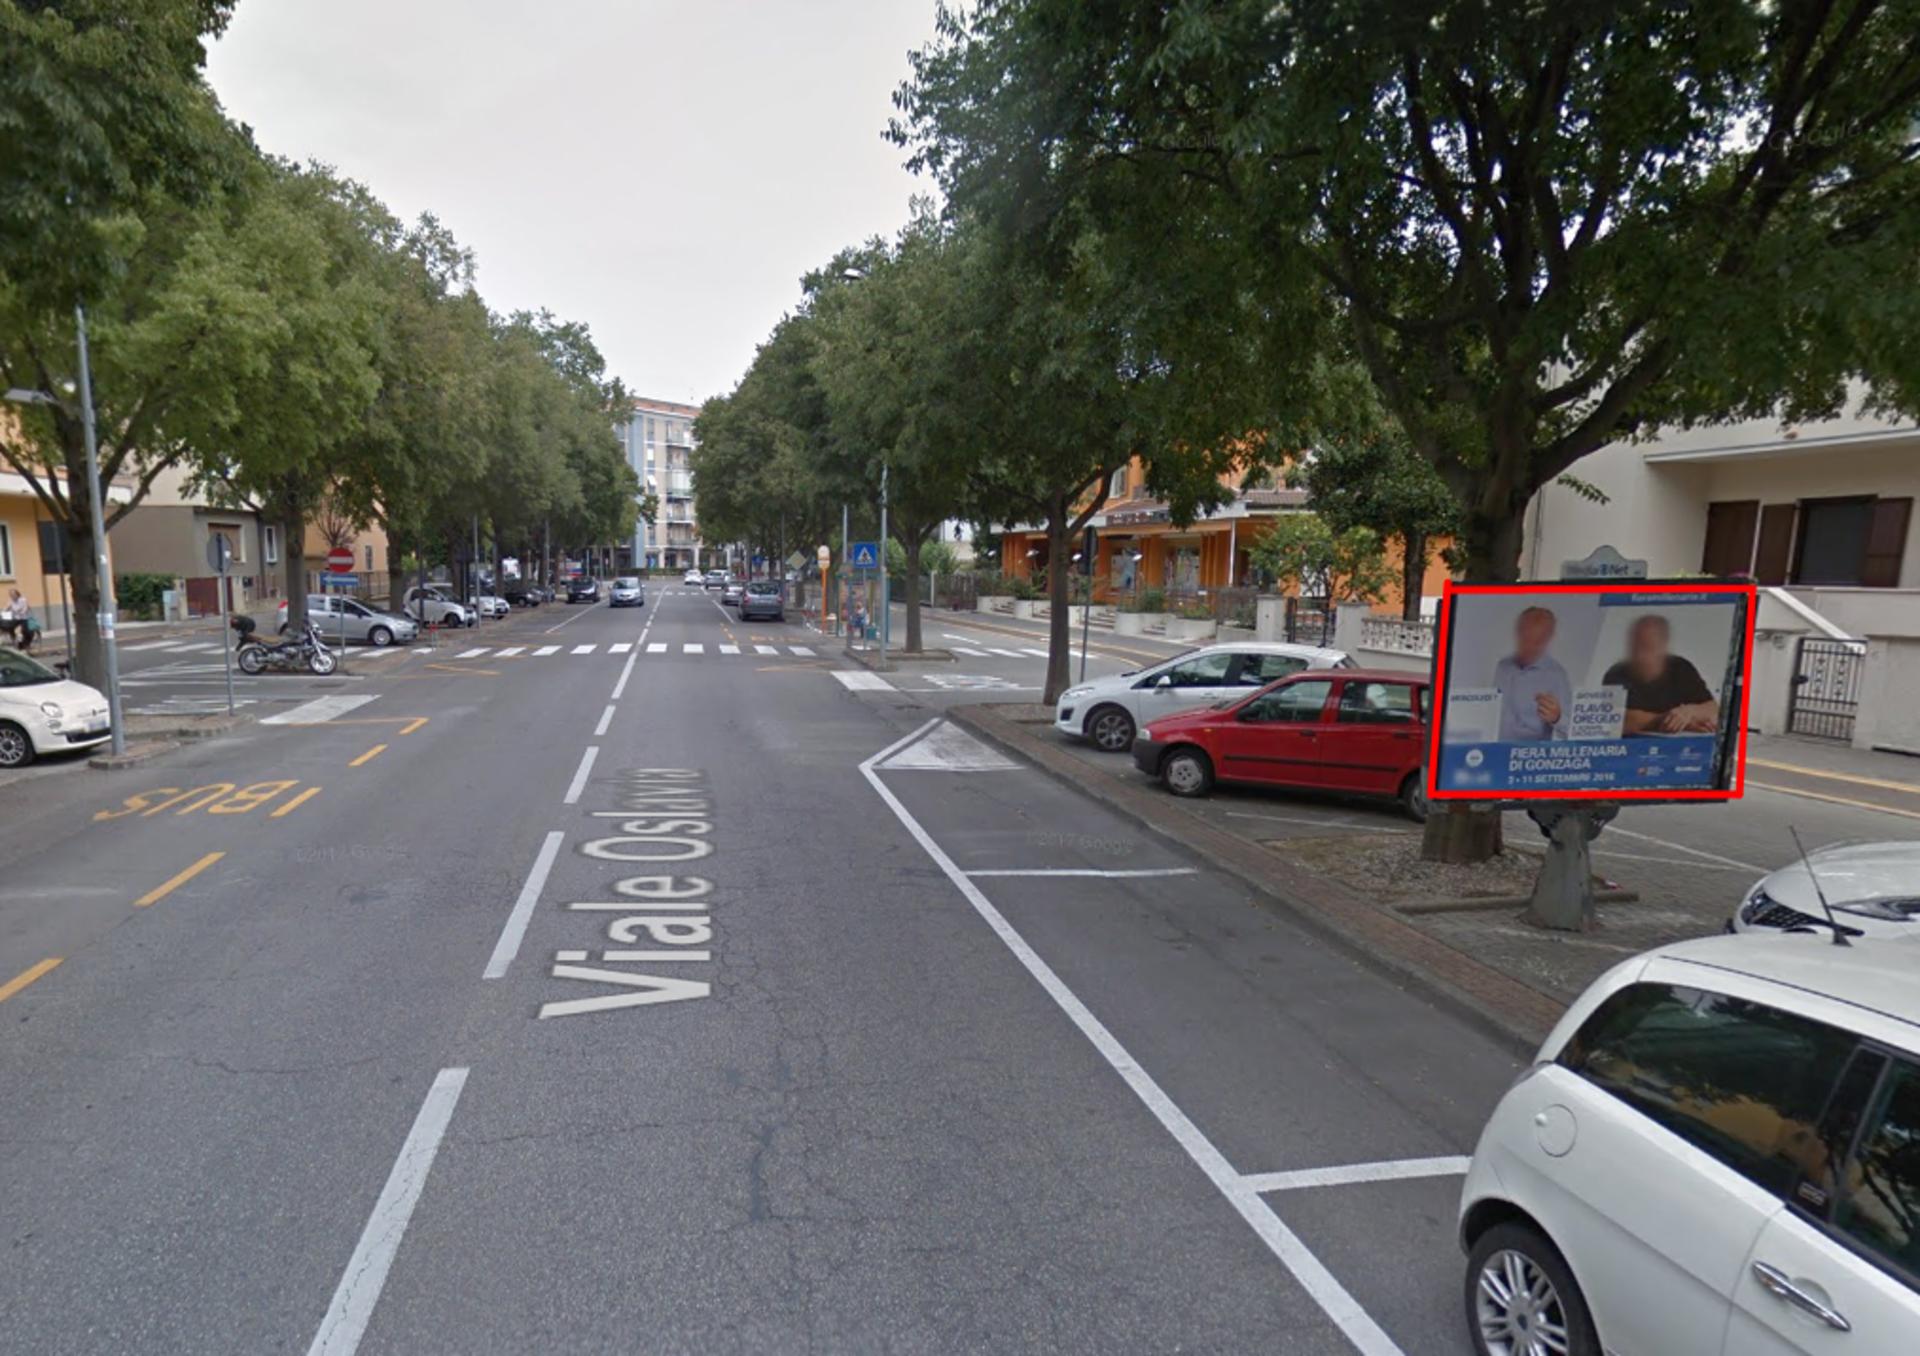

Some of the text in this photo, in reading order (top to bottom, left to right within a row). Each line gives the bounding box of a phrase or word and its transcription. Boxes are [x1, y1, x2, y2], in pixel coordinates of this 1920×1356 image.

[1574, 703, 1613, 713] FLAVIO
[1510, 745, 1627, 759] FIERA MILLENARIA
[1509, 758, 1591, 772] DI GONZAGA
[1535, 772, 1591, 783] SETTEMBRE
[93, 779, 299, 820] BUS
